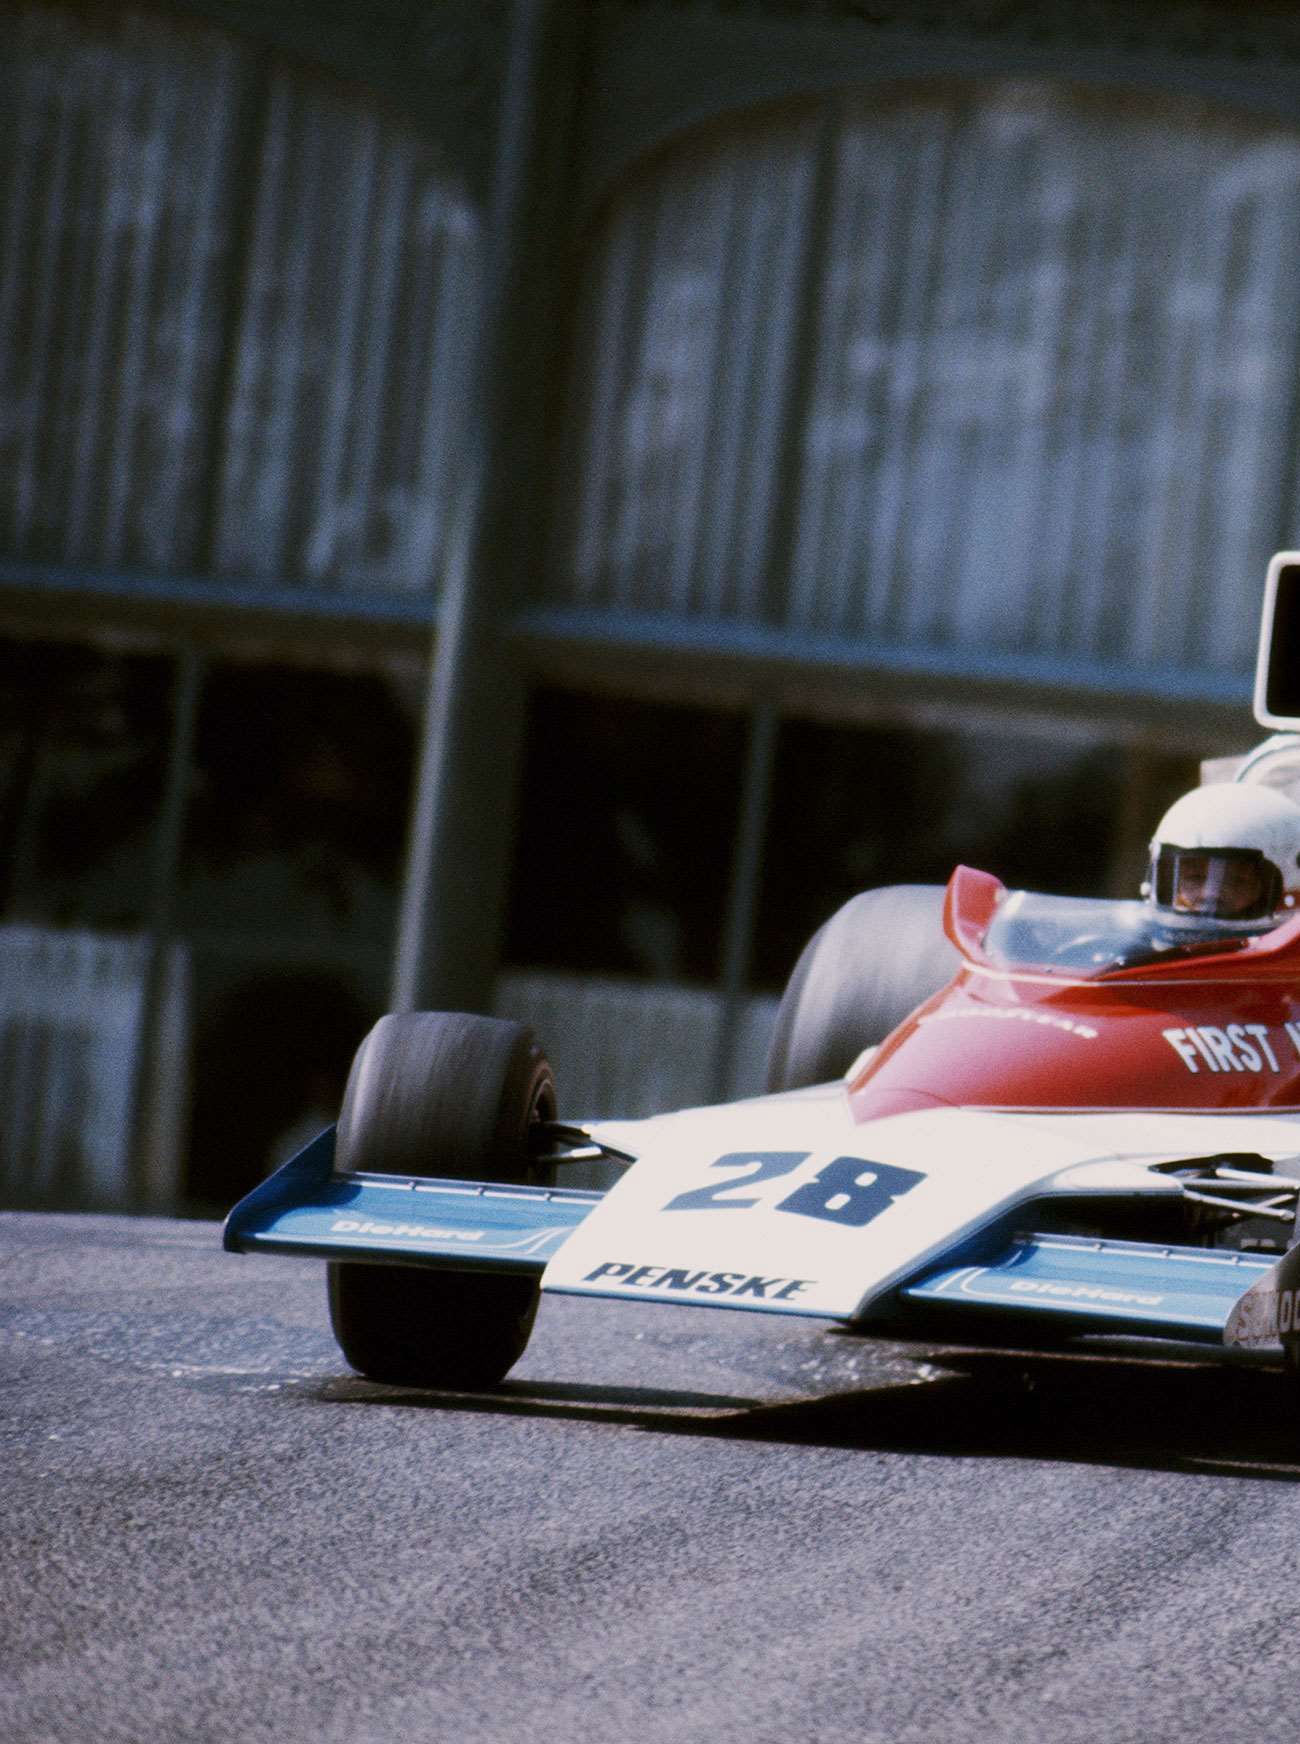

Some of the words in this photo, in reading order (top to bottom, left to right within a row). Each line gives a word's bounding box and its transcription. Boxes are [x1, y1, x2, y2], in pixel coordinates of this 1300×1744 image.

[1162, 1023, 1281, 1074] FIRST
[660, 1151, 928, 1228] 28
[580, 1262, 819, 1301] PENSKE
